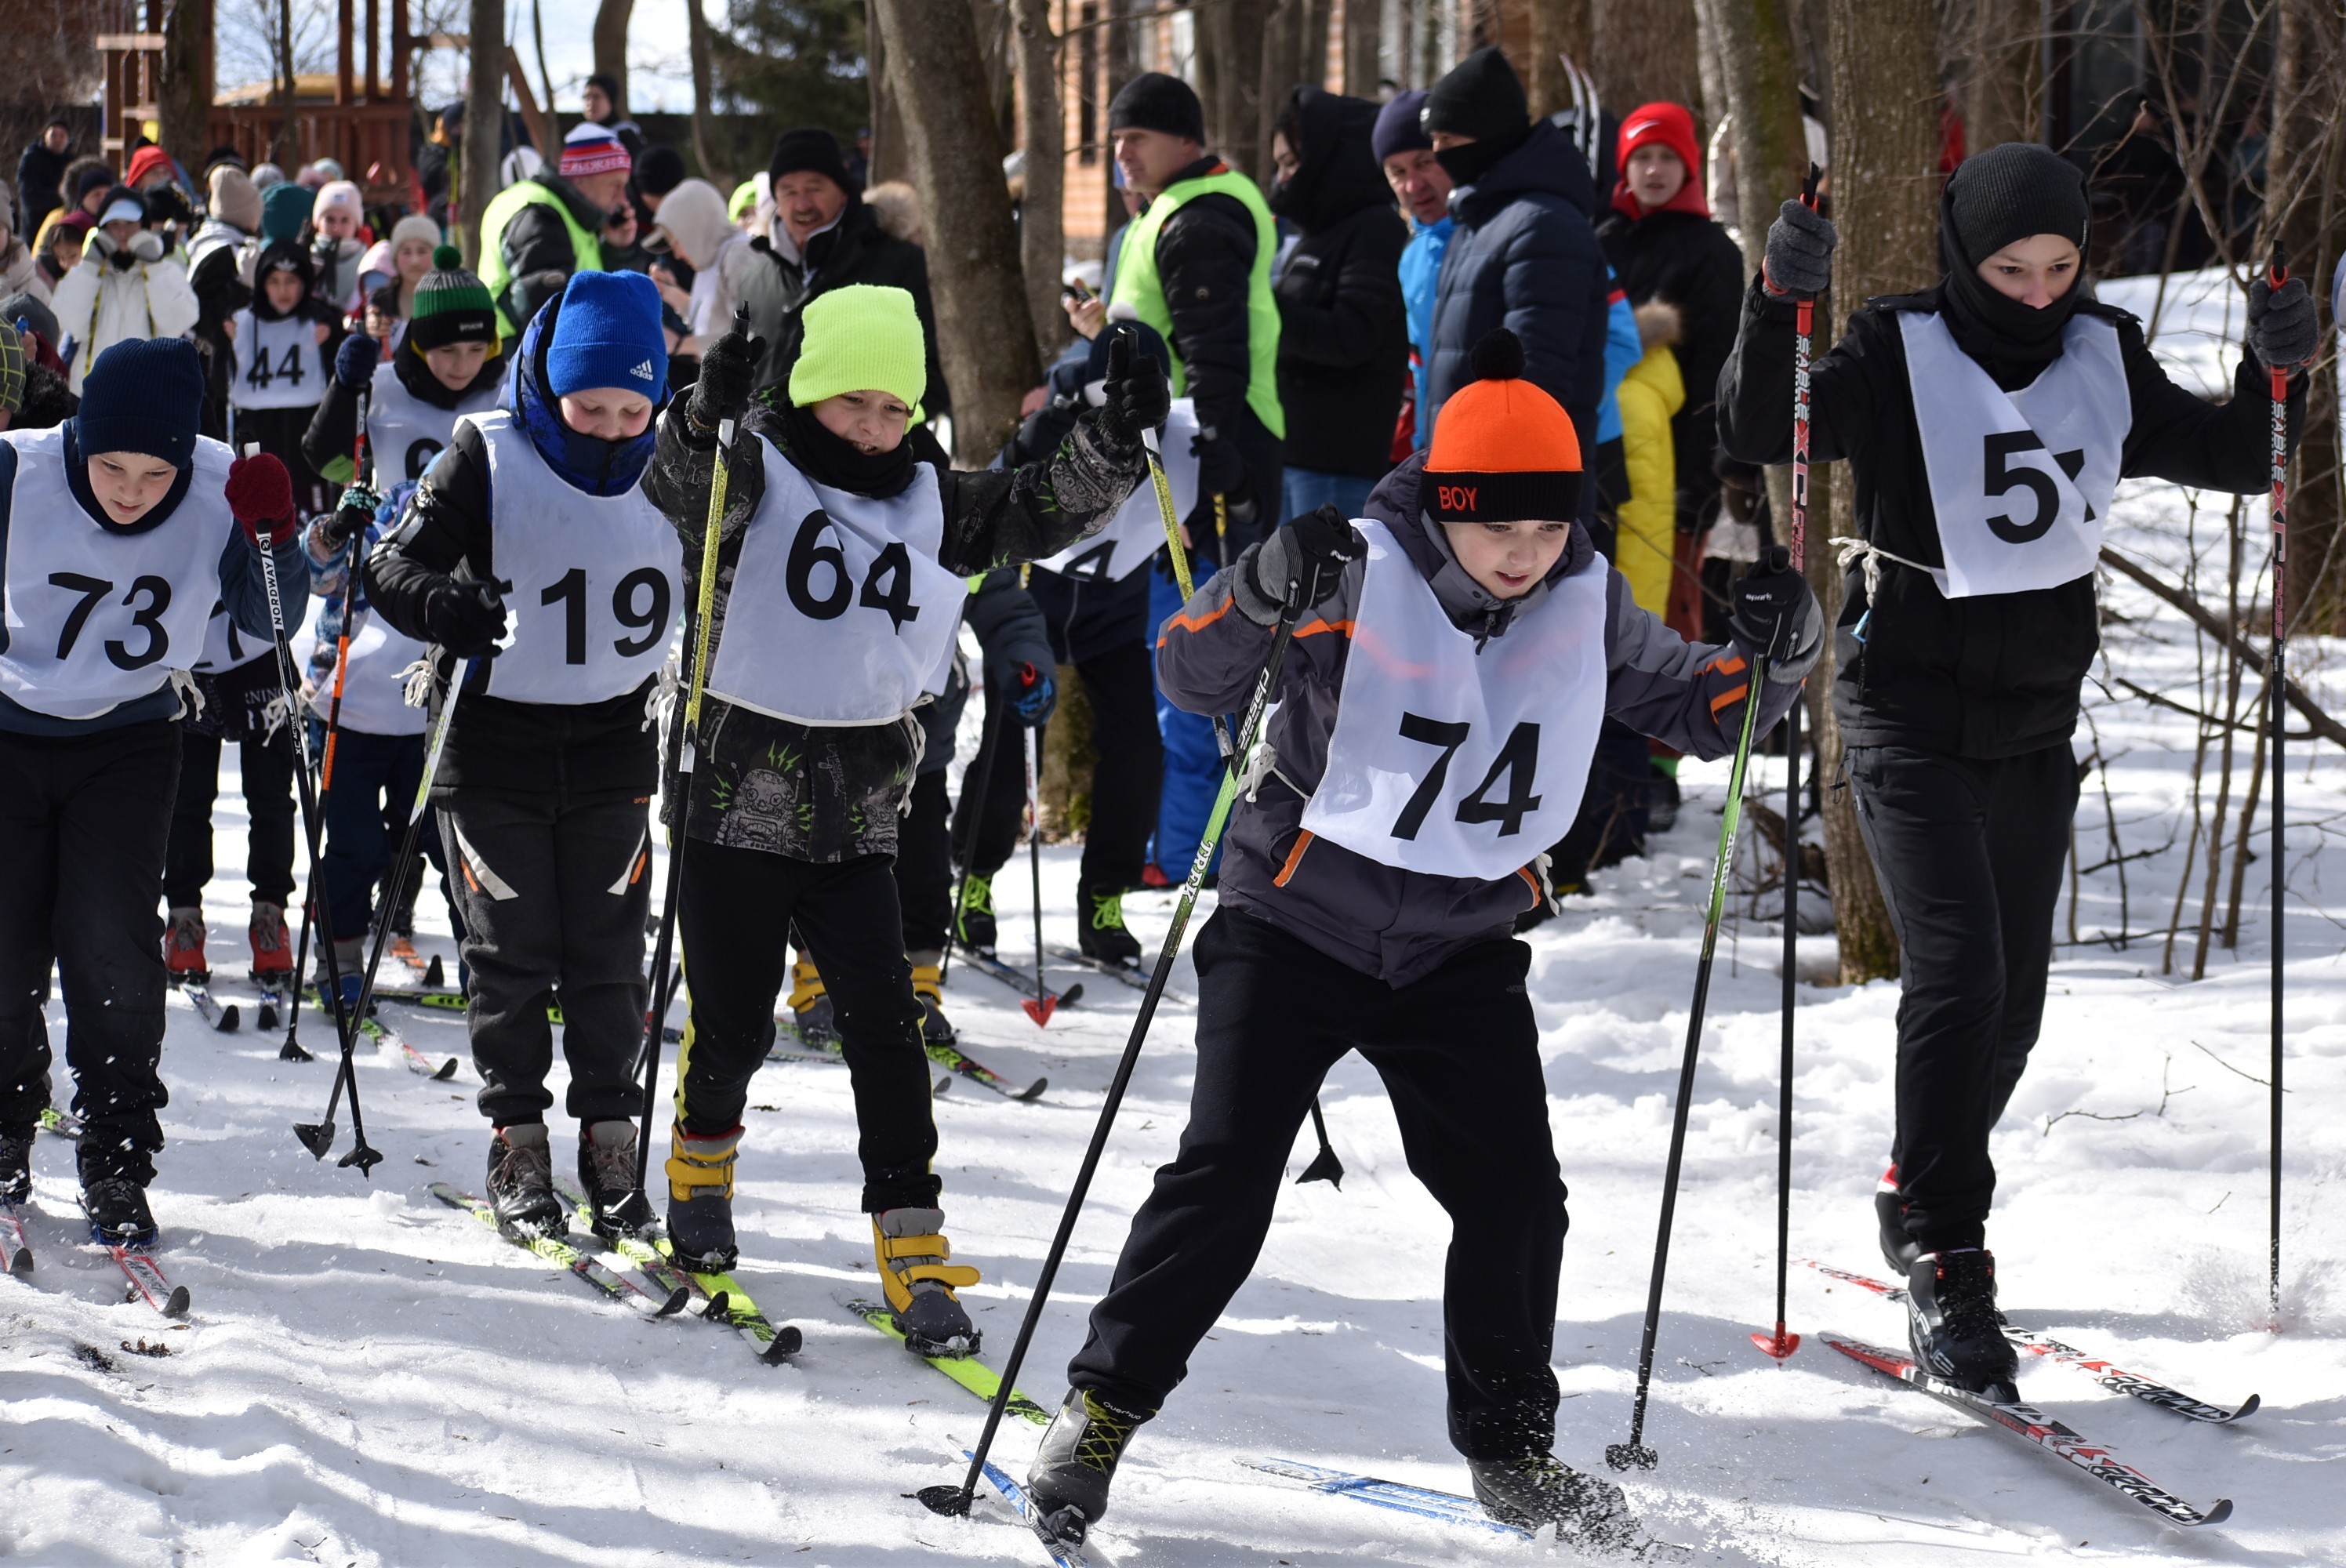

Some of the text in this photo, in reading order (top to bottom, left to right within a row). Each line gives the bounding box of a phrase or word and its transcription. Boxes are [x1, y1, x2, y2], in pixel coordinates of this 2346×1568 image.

[247, 344, 305, 389] 44
[630, 368, 654, 381] adidas
[1796, 337, 1810, 422] SABLE
[2272, 401, 2285, 483] SABLE
[1438, 486, 1477, 511] BOY
[264, 561, 282, 626] NORDWAY
[786, 509, 921, 636] 64
[48, 572, 172, 671] 73
[541, 567, 671, 665] 19
[289, 715, 303, 756] XC ACTIVE
[1390, 710, 1543, 841] 74
[1182, 840, 1215, 904] TREK
